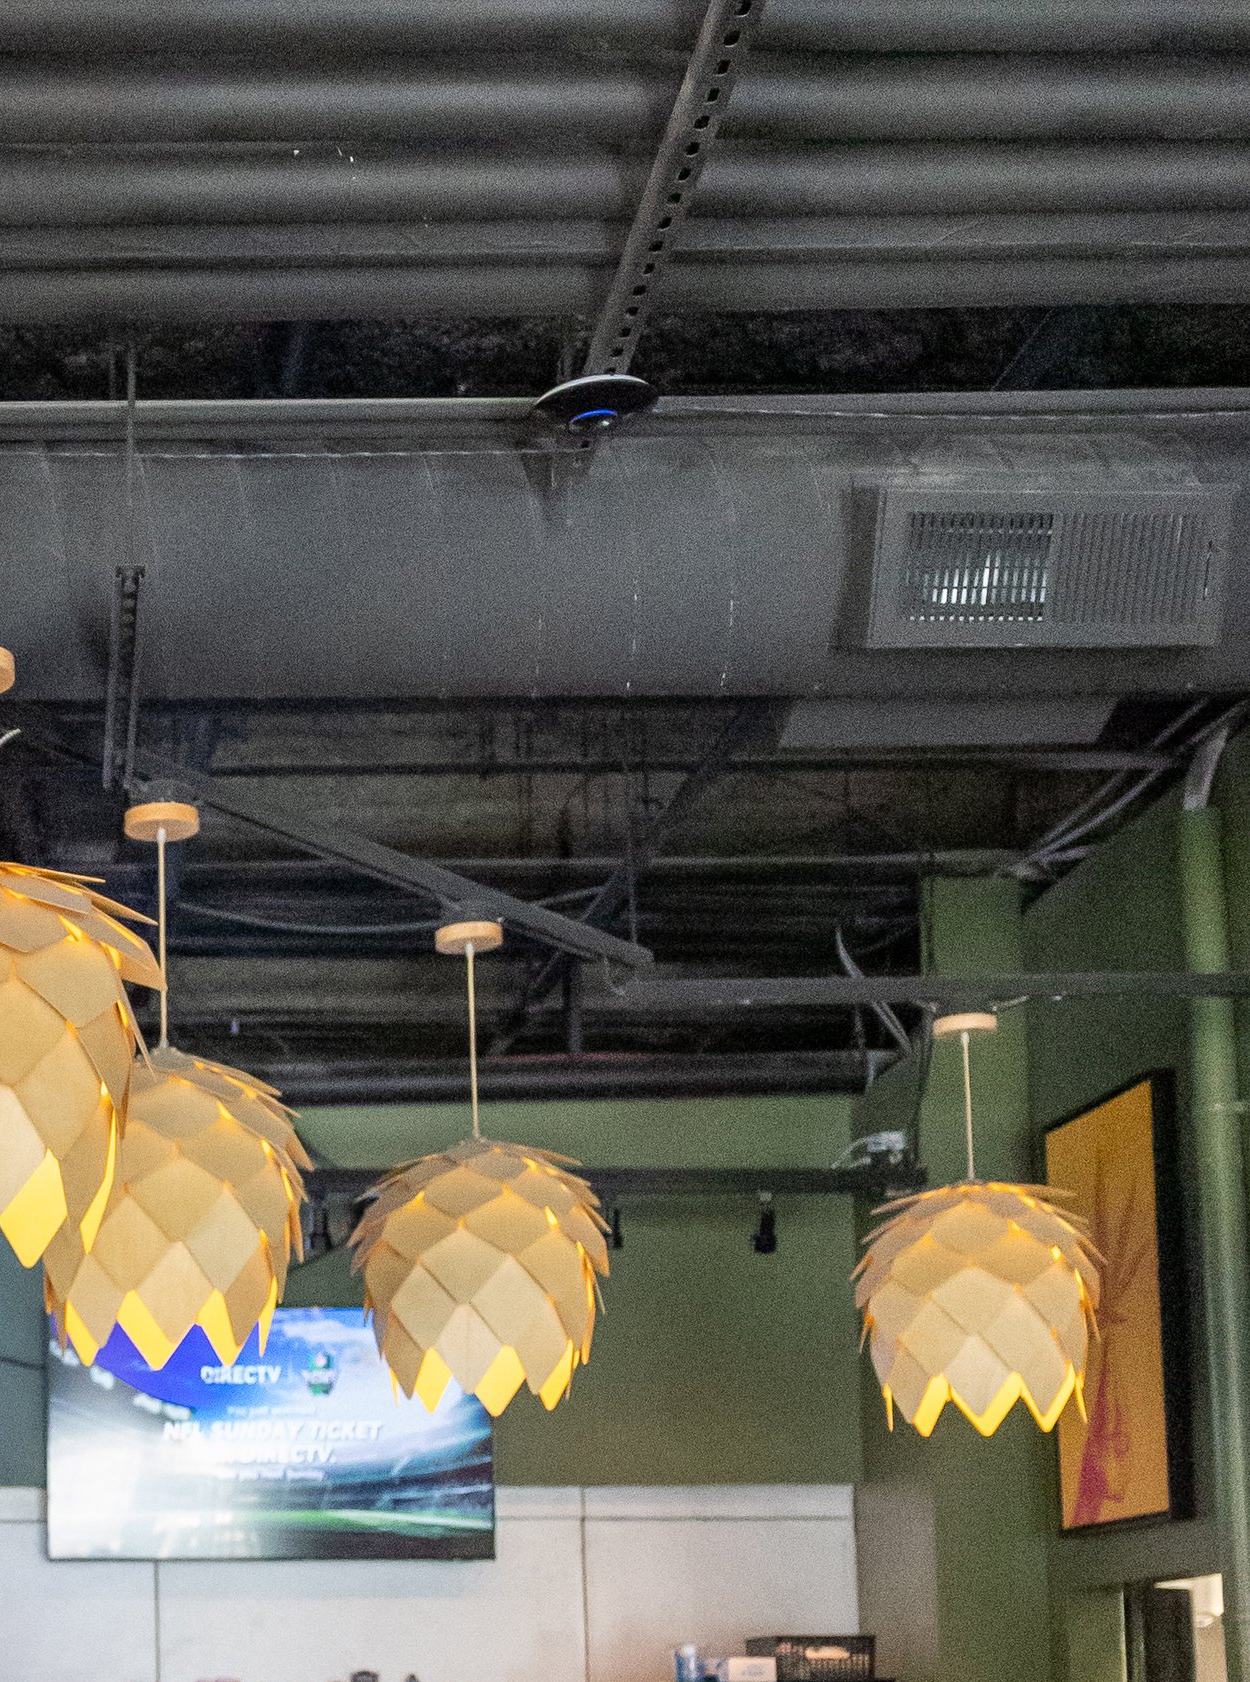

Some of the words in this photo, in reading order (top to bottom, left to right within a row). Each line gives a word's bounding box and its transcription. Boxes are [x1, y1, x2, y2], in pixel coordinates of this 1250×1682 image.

[200, 1365, 282, 1385] DIRECTV
[210, 1420, 303, 1442] SUNDAY
[309, 1420, 383, 1442] TICKET
